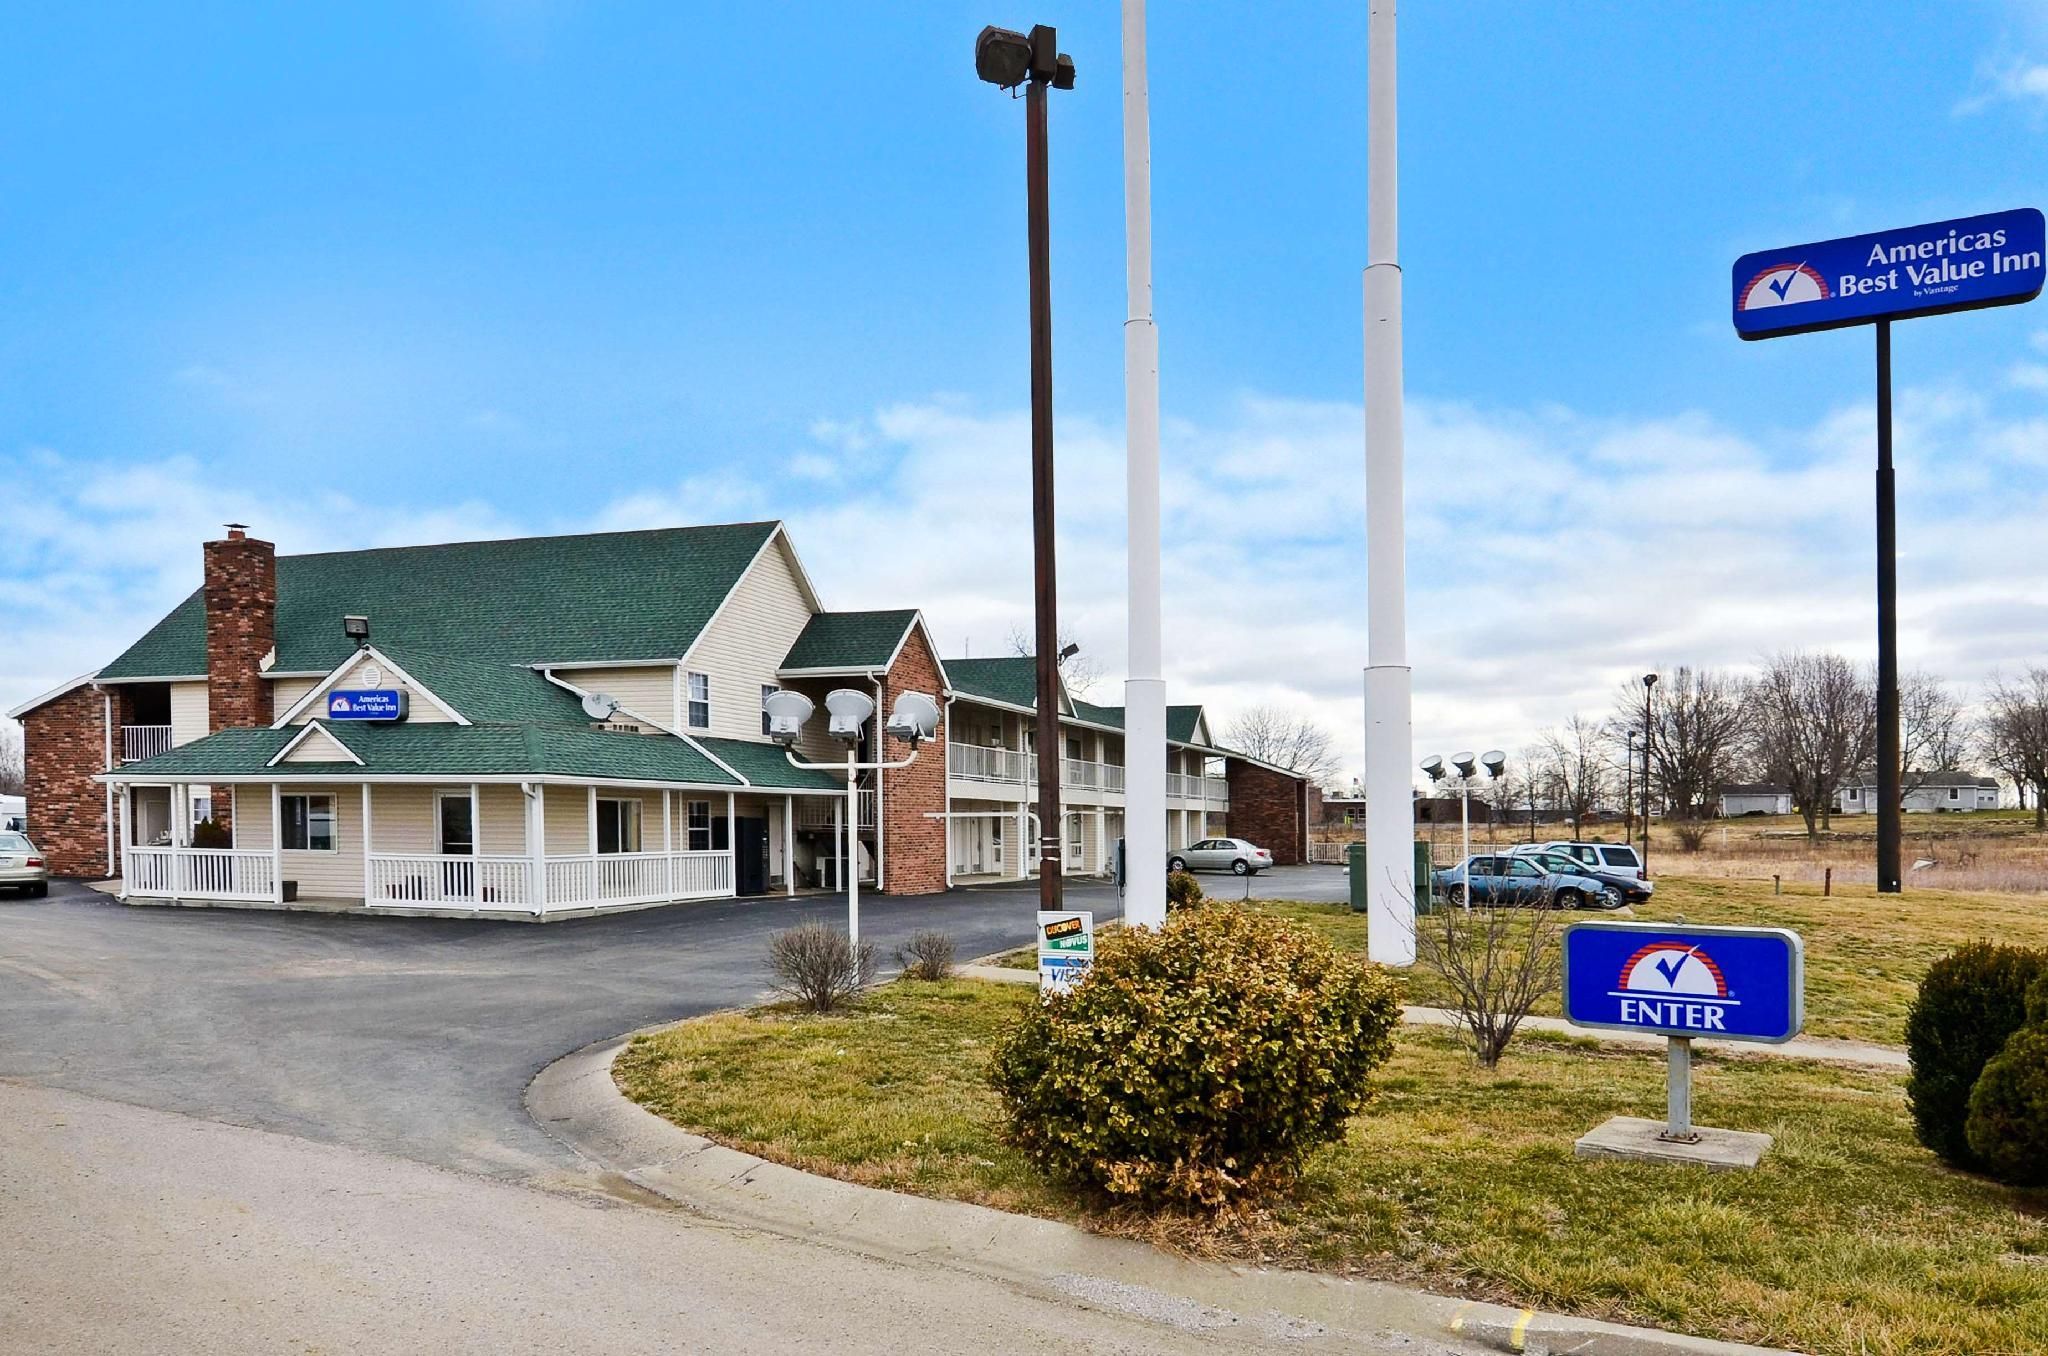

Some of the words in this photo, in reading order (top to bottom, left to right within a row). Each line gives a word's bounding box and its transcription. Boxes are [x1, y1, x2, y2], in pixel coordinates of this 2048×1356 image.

[1866, 229, 2007, 267] Americas
[1839, 269, 1899, 297] Best
[1905, 258, 1985, 287] Value
[1993, 250, 2041, 274] Inn
[1913, 288, 1923, 297] by
[1923, 285, 1959, 295] Vantage
[358, 694, 389, 703] Americas
[352, 703, 366, 712] Best
[367, 703, 385, 712] Value
[385, 703, 396, 711] Inn
[1060, 935, 1087, 948] NOVUS
[1620, 999, 1727, 1031] ENTER
